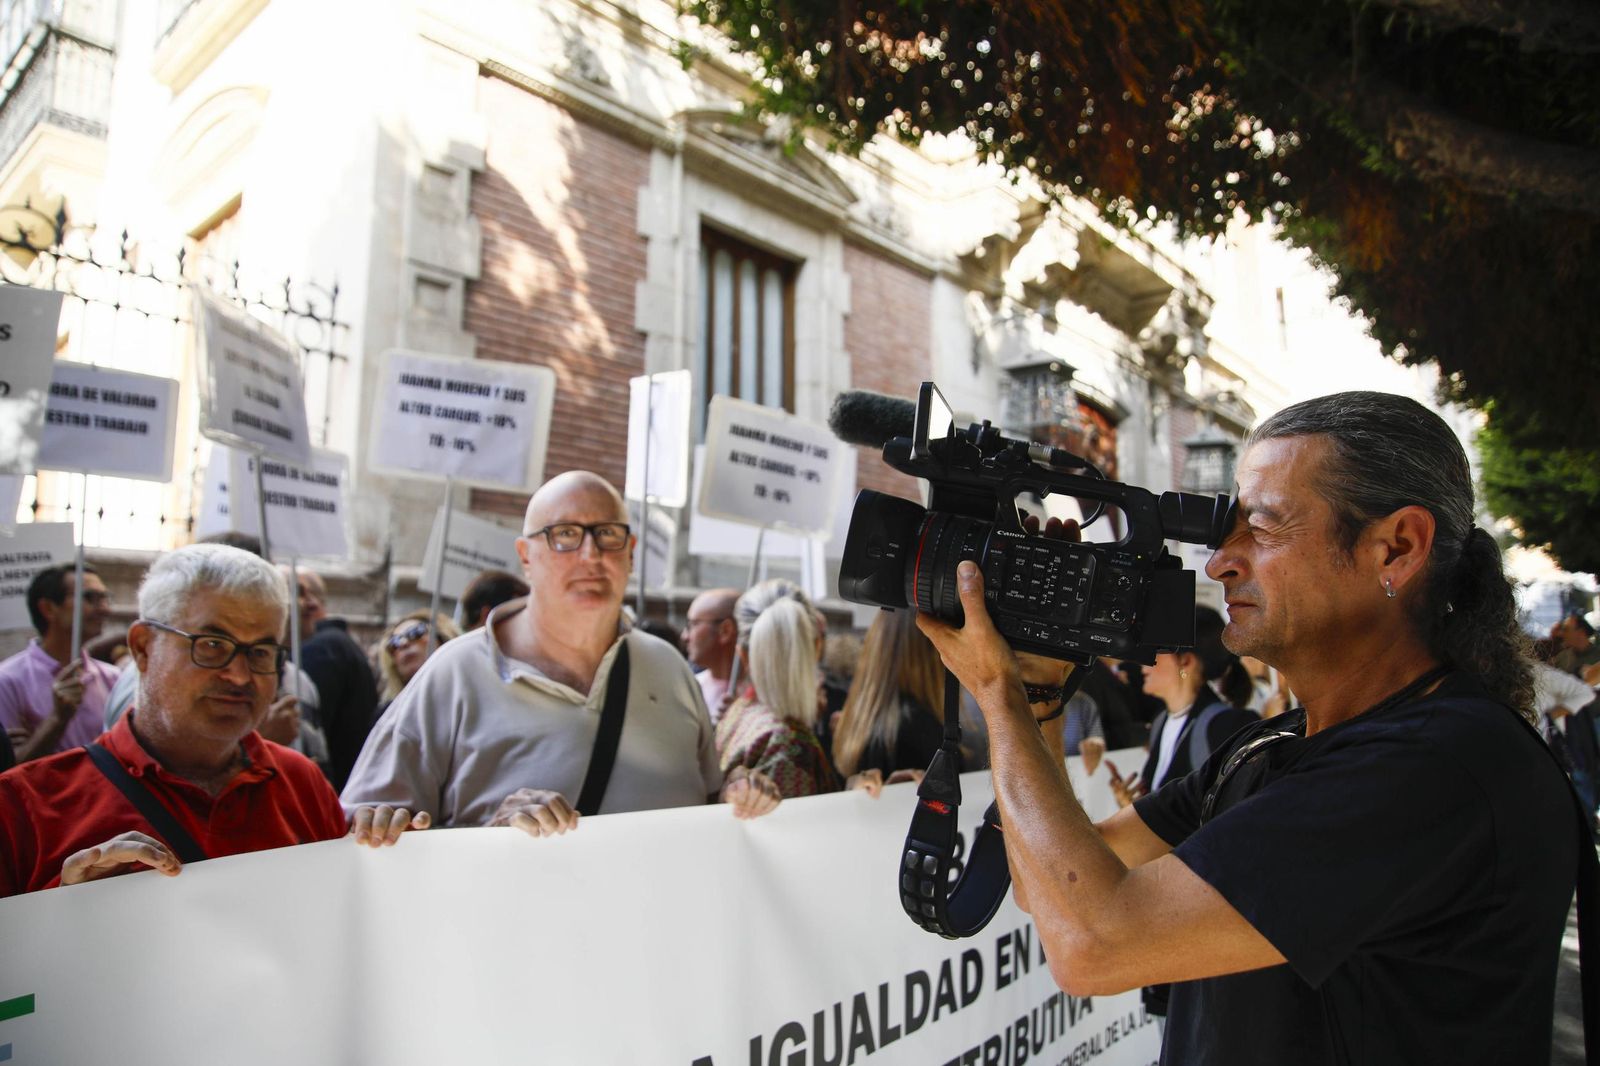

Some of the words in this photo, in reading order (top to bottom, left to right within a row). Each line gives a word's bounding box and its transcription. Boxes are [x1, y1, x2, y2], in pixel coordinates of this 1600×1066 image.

[49, 382, 79, 399] ORA
[81, 386, 98, 403] DE
[445, 379, 490, 397] MORENO
[45, 409, 90, 428] ESTRO
[996, 530, 1026, 540] Canon
[0, 551, 52, 565] ALTRATA
[996, 922, 1032, 992] EN
[1105, 1020, 1120, 1043] DE
[1121, 1008, 1136, 1036] LA
